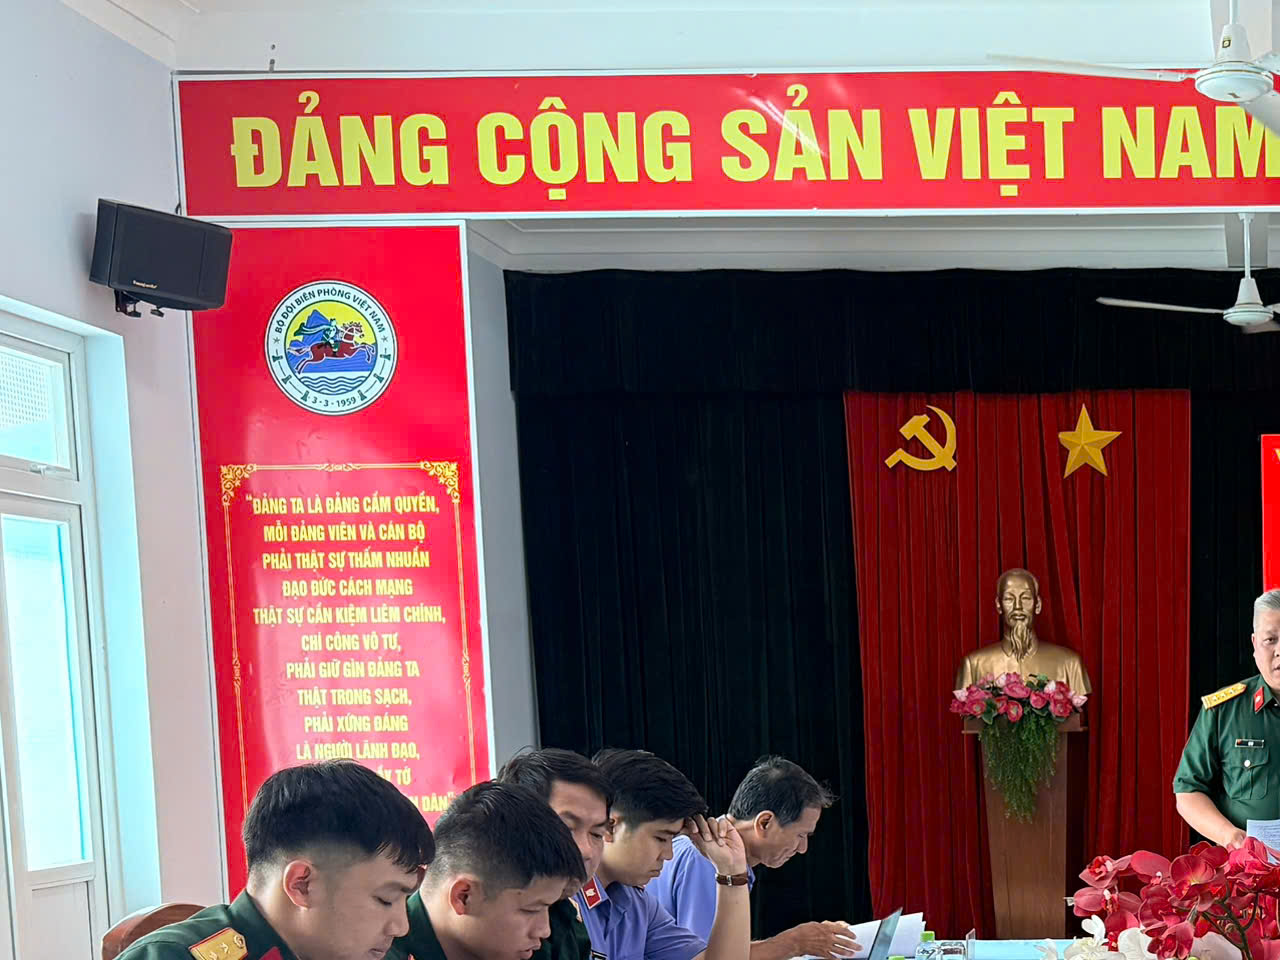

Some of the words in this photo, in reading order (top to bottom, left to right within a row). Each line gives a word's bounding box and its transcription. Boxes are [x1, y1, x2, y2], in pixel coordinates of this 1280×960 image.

[230, 89, 450, 187] ĐẢNG
[477, 97, 692, 200] CỘNG
[720, 83, 885, 181] SẢN
[906, 90, 1076, 196] VIỆT
[275, 319, 286, 334] BỘ
[282, 302, 297, 318] ĐỘI
[296, 290, 316, 306] BIÊN
[317, 288, 351, 300] PHÒNG
[352, 294, 372, 313] VIỆT
[369, 311, 386, 333] NAM
[289, 497, 304, 514] TA
[308, 494, 322, 513] LÀ
[325, 491, 360, 513] ĐẢNG
[291, 520, 325, 541] ĐẢNG
[328, 522, 356, 541] VIÊN
[360, 521, 376, 540] VÀ
[379, 521, 405, 540] CÁN
[408, 520, 426, 543] BỘ
[262, 548, 292, 569] PHẢI
[295, 550, 324, 572] THẬT
[328, 551, 345, 571] SỰ
[282, 580, 307, 600] ĐẠO
[311, 577, 336, 596] ĐỨC
[339, 576, 372, 595] CÁCH
[376, 579, 412, 598] MẠNG
[253, 605, 282, 627] THẬT
[287, 607, 303, 627] SỰ
[336, 604, 367, 626] KIỆM
[370, 604, 400, 623] LIÊM
[404, 603, 446, 624] CHÍNH,
[301, 632, 322, 651] CHÍ
[325, 631, 360, 650] CÔNG
[363, 631, 379, 650] VÔ
[286, 657, 315, 678] PHẢI
[368, 656, 402, 677] ĐẢNG
[405, 661, 420, 677] TA
[297, 686, 327, 708] THẬT
[330, 689, 372, 705] TRONG
[375, 688, 412, 708] SẠCH,
[304, 712, 333, 732] PHẢI
[337, 712, 370, 732] XỨNG
[374, 713, 408, 731] ĐÁNG
[296, 741, 311, 760] LÀ
[356, 741, 388, 759] LÃNH
[392, 743, 420, 761] ĐẠO,
